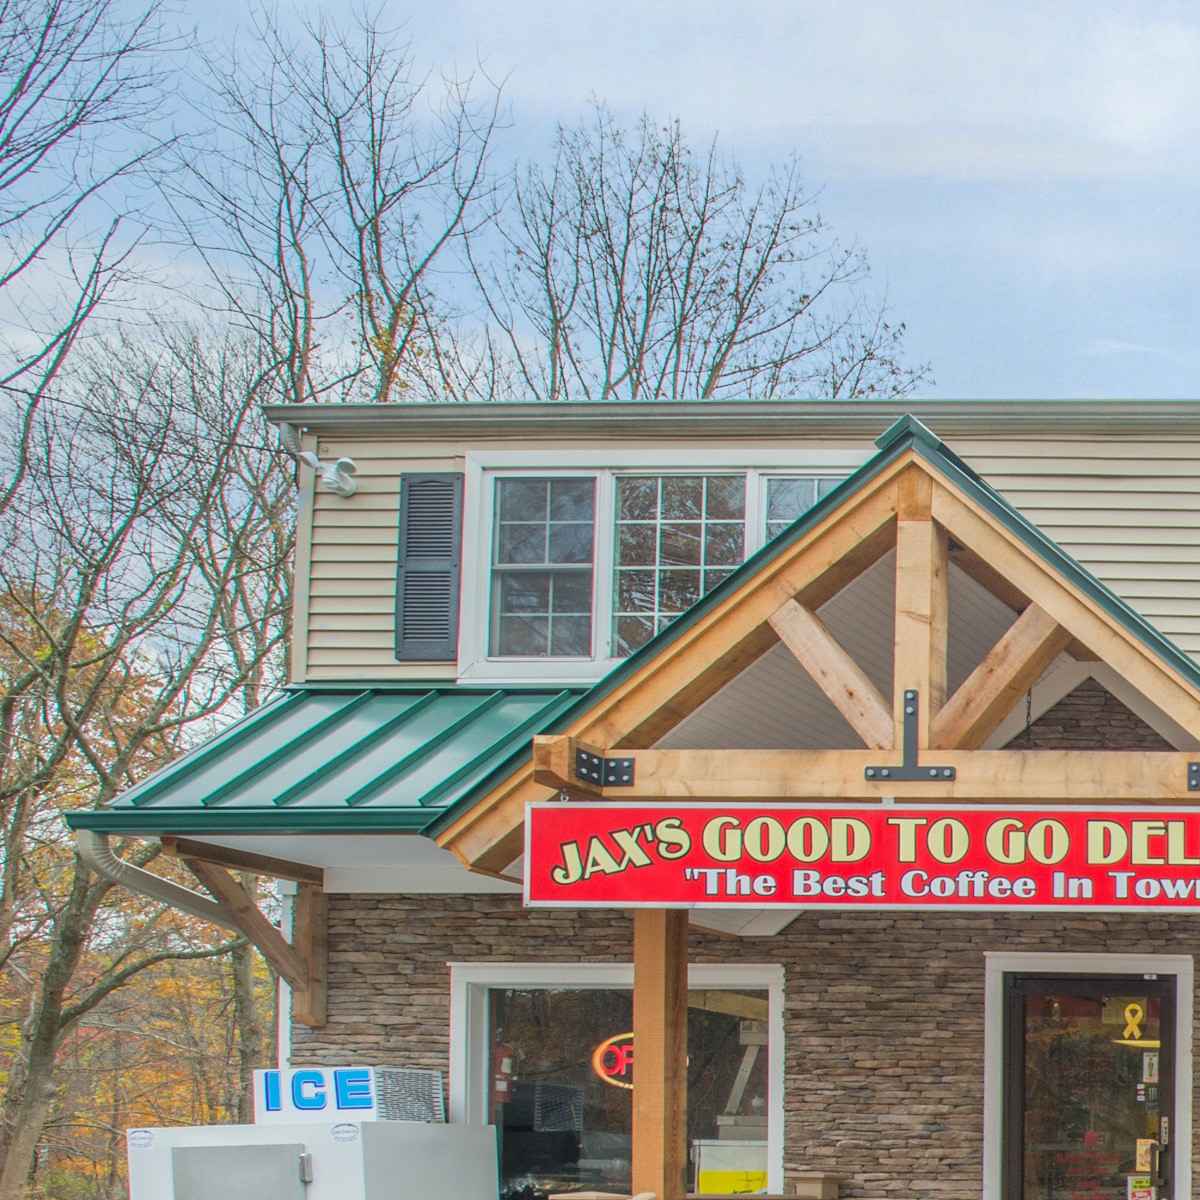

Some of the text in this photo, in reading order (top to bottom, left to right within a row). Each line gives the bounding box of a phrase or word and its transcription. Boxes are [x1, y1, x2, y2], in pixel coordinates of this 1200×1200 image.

[551, 817, 692, 885] JAX'S
[702, 815, 872, 863] GOOD
[886, 817, 971, 864] TO
[985, 817, 1070, 865] GO
[684, 868, 777, 896] "The
[792, 868, 886, 897] Best
[900, 870, 1037, 898] Coffee
[1052, 871, 1093, 899] In
[603, 1044, 635, 1076] OP
[264, 1069, 375, 1112] ICE
